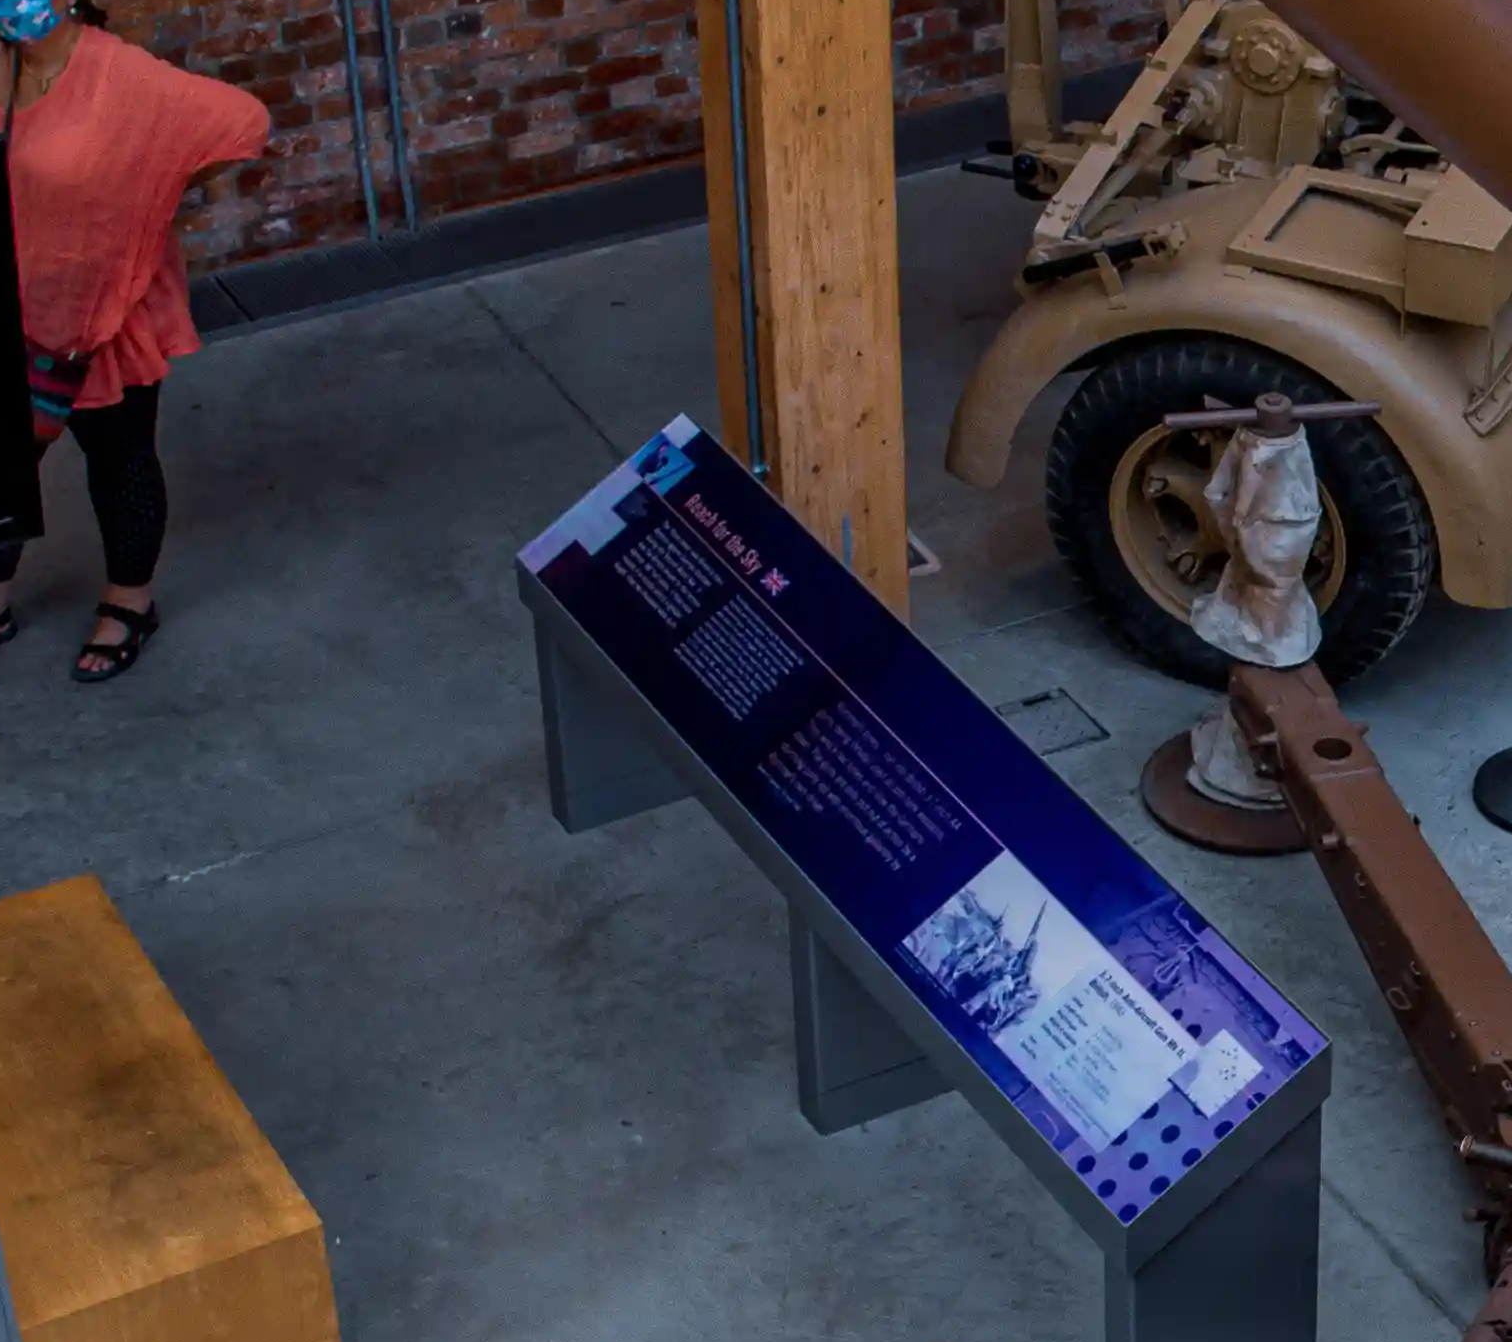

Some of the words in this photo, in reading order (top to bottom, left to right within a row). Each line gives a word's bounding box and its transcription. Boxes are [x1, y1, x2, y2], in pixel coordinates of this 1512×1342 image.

[684, 493, 718, 527] Reach
[711, 519, 731, 540] for
[724, 534, 745, 557] the
[739, 548, 762, 575] Sky
